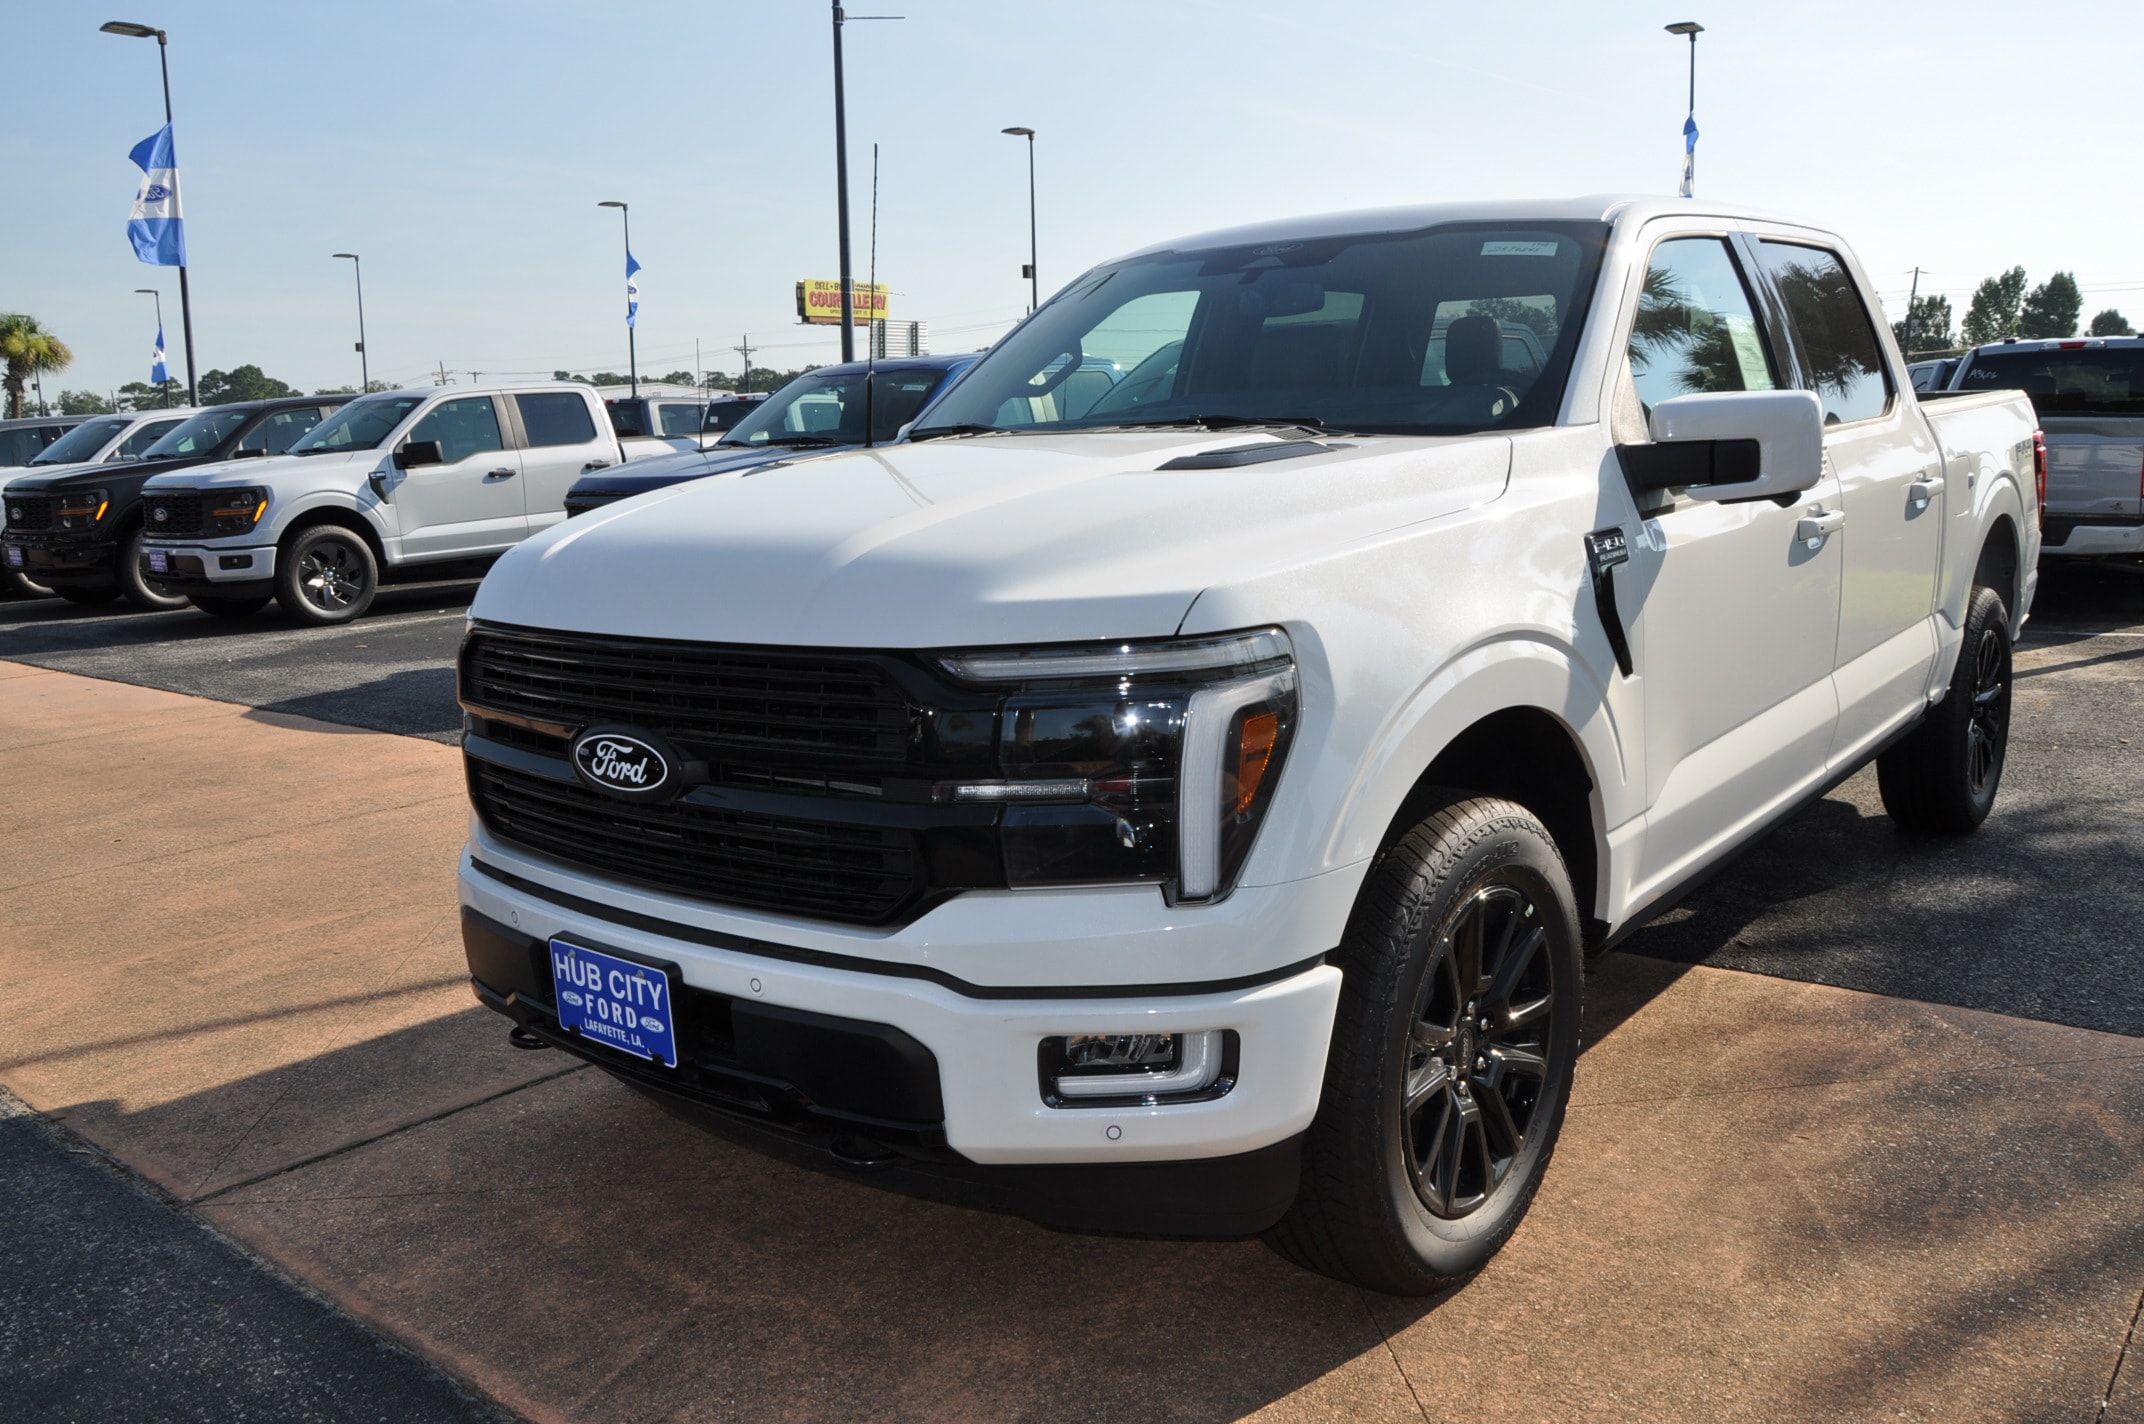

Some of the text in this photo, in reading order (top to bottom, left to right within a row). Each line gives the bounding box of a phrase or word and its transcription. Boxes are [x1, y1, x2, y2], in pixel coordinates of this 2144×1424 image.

[808, 290, 871, 310] COURLLE
[814, 281, 830, 291] SELL
[591, 740, 648, 784] Ford
[554, 952, 663, 1011] HUB CITY
[584, 993, 638, 1029] FORD
[584, 1017, 645, 1049] LAFAYETTE, LA.
